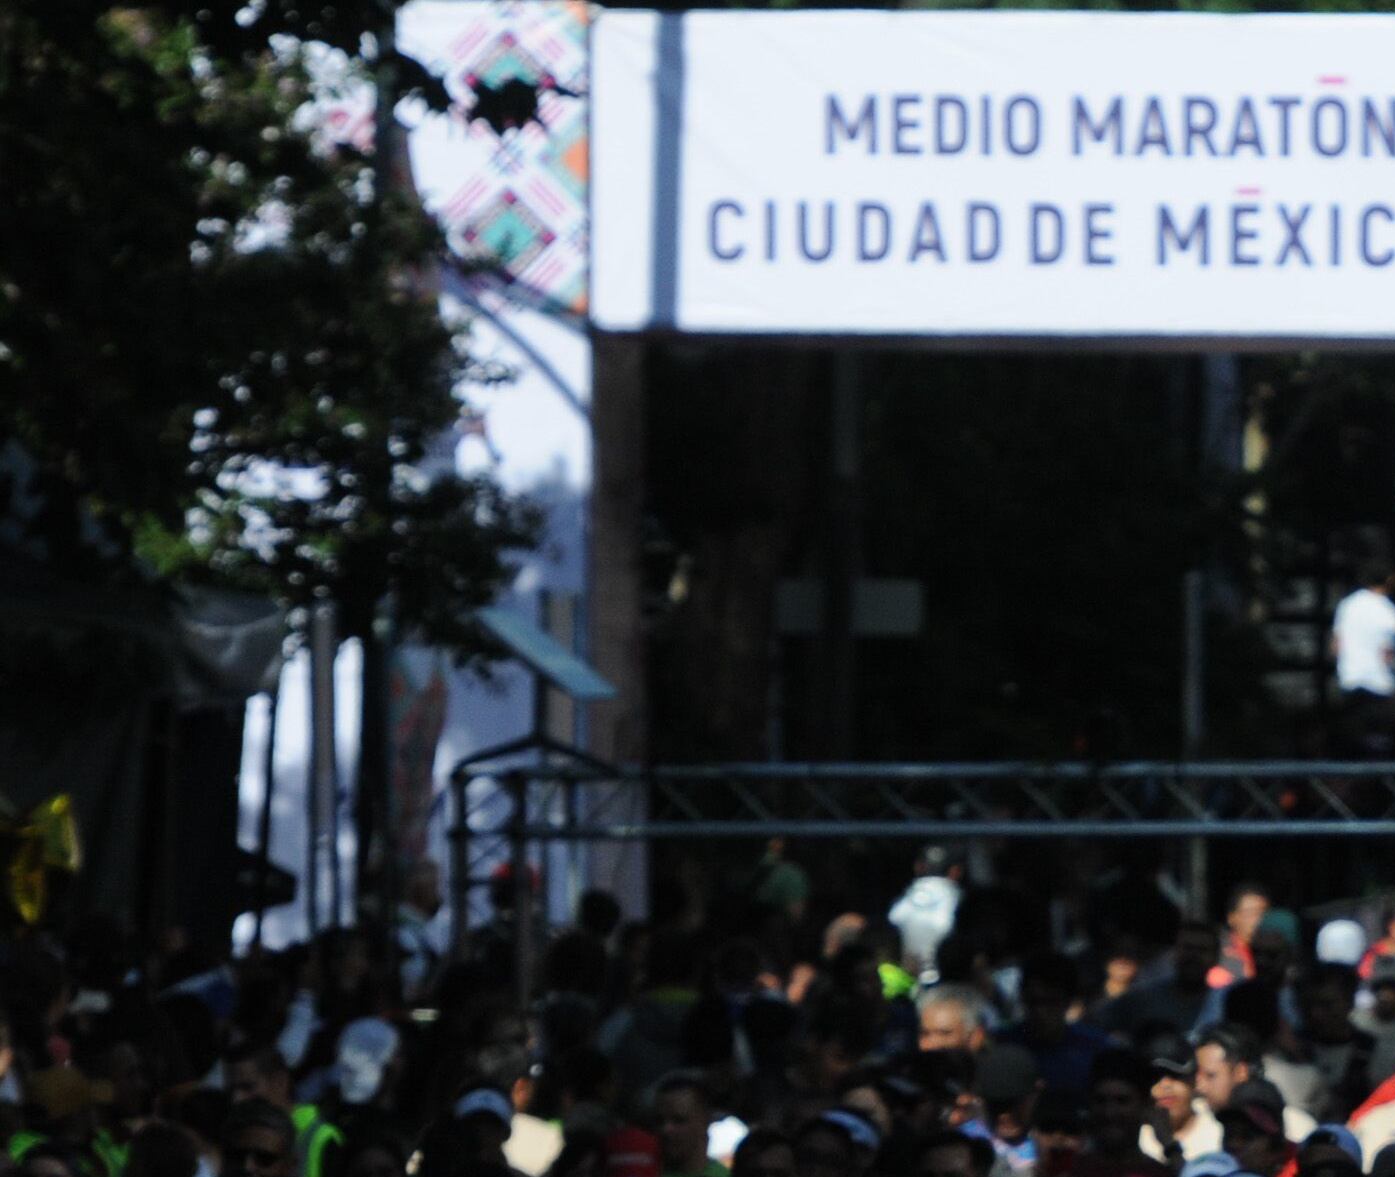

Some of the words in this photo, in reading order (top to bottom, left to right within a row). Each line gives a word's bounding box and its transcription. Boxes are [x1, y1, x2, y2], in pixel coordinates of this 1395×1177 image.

[823, 93, 1044, 157] MEDIO
[706, 199, 1003, 264] CIUDAD
[1027, 202, 1115, 267] DE
